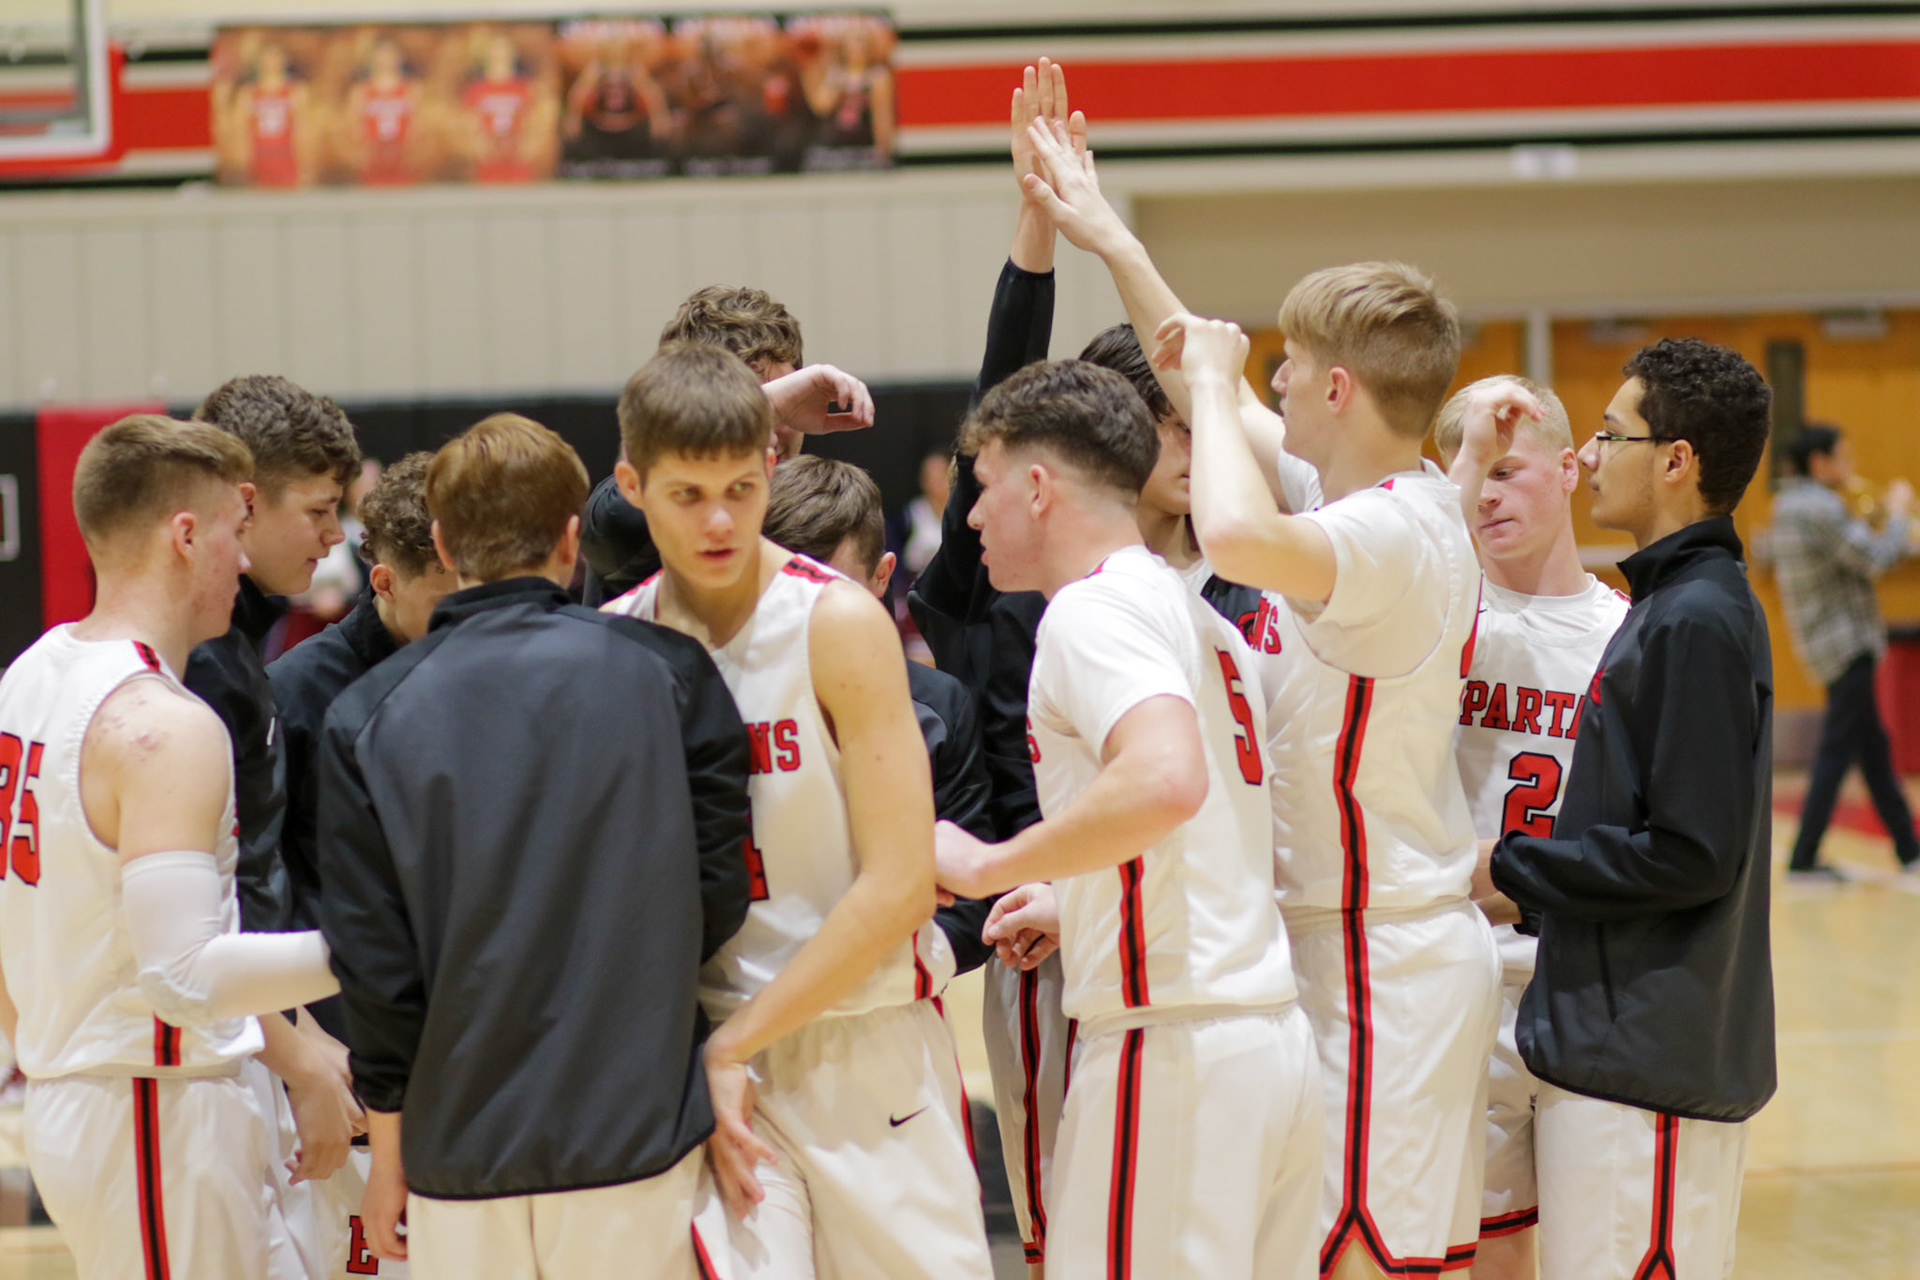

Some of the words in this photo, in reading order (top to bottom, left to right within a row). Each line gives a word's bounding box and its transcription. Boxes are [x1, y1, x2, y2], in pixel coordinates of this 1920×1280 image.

[1214, 645, 1263, 786] 5
[1459, 680, 1585, 740] PART
[1501, 751, 1563, 839] 2
